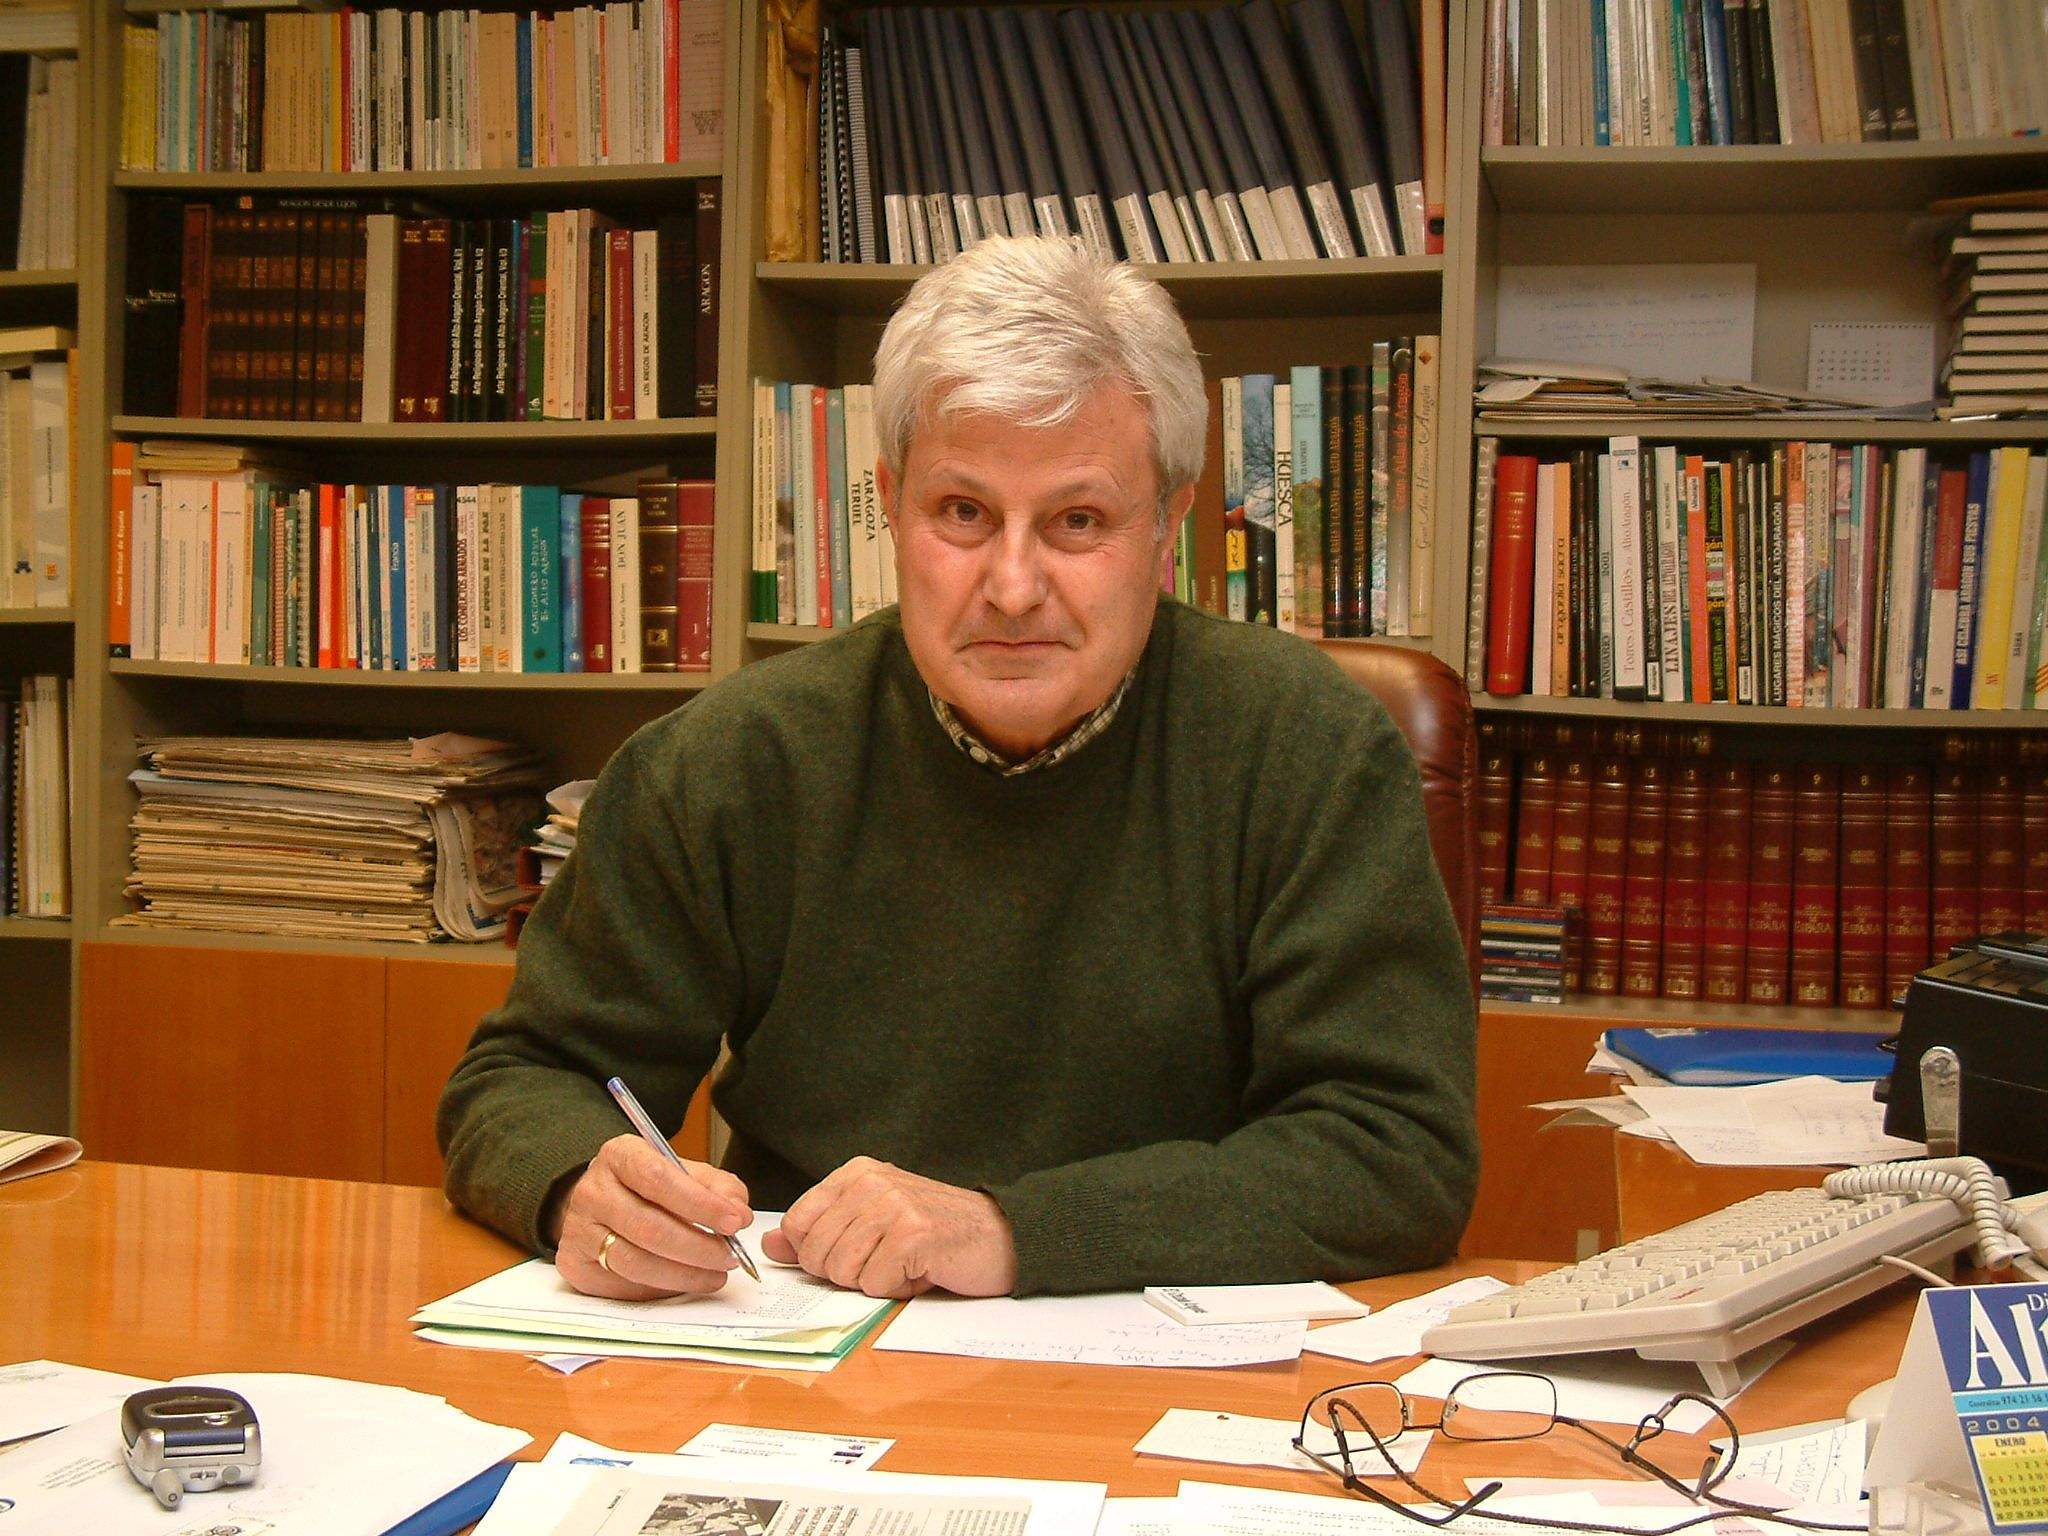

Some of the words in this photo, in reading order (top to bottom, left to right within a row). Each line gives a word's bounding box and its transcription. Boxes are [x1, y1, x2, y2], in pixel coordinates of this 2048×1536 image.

[643, 345, 650, 354] DE
[1392, 424, 1408, 438] de
[850, 482, 862, 525] TERUEL
[863, 468, 876, 542] ZARAGOZA
[1276, 450, 1292, 527] HUESCA
[1474, 445, 1489, 547] SANCHEZ
[117, 510, 125, 538] España
[617, 510, 627, 539] JUAN
[1966, 503, 1979, 542] FIESTAS
[116, 540, 125, 549] de
[457, 539, 467, 577] ARMADOS
[617, 543, 626, 568] DON
[1964, 545, 1976, 563] SUS
[1601, 551, 1610, 577] 2001
[457, 579, 468, 626] CONFLICTOS
[1620, 568, 1634, 627] Castillos
[1773, 578, 1782, 598] DEL
[1959, 565, 1974, 602] ARAGON
[457, 627, 468, 642] LOS
[1469, 565, 1483, 681] GERVASIO
[1663, 606, 1679, 673] LINAJES
[1772, 600, 1782, 649] MÁGICOS
[1956, 605, 1970, 646] CELEBRA
[1602, 635, 1610, 685] ANUARIO
[1773, 651, 1782, 701] LUGARES
[1966, 1416, 2040, 1433] 2004
[1994, 1437, 2026, 1448] ENERO
